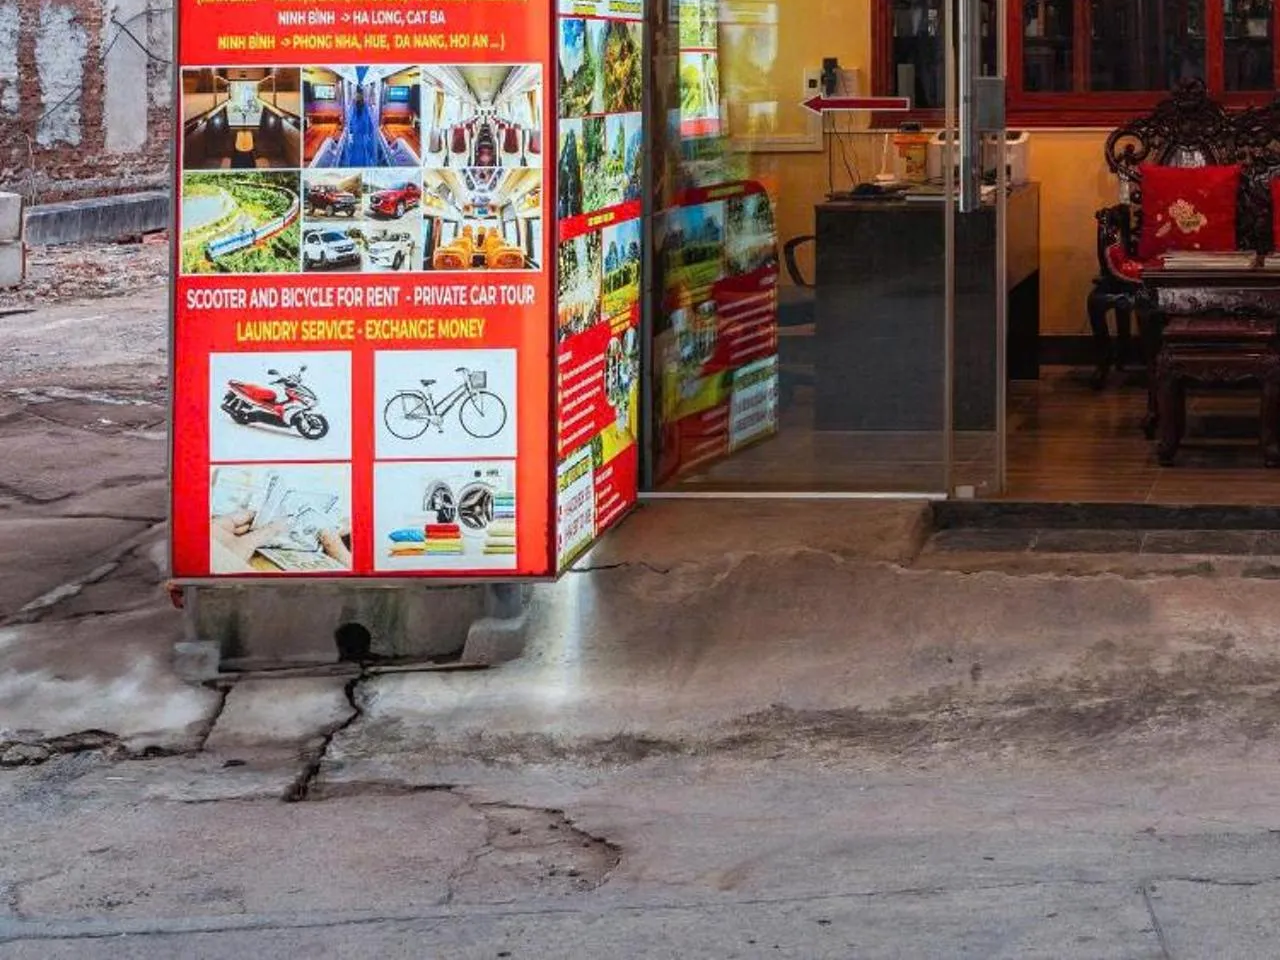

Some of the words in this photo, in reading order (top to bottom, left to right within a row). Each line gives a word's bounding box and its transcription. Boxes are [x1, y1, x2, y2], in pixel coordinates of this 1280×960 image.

[278, 11, 306, 25] NINH
[352, 11, 369, 24] HA
[371, 11, 405, 26] LONG,
[406, 10, 429, 24] CAT
[430, 10, 446, 24] BA
[218, 36, 246, 49] NINH
[293, 35, 333, 49] PHONG
[472, 34, 488, 48] AN
[186, 289, 246, 309] SCOOTER
[250, 288, 278, 308] AND
[281, 288, 334, 307] BICYCLE
[337, 287, 363, 307] FOR
[366, 287, 400, 307] RENT
[414, 286, 467, 305] PRIVATE
[470, 286, 496, 305] CAR
[500, 285, 535, 304] TOUR
[236, 321, 298, 341] LAUNDRY
[301, 320, 355, 340] SERVICE
[365, 319, 436, 339] EXCHANGE
[438, 318, 485, 338] MONEY
